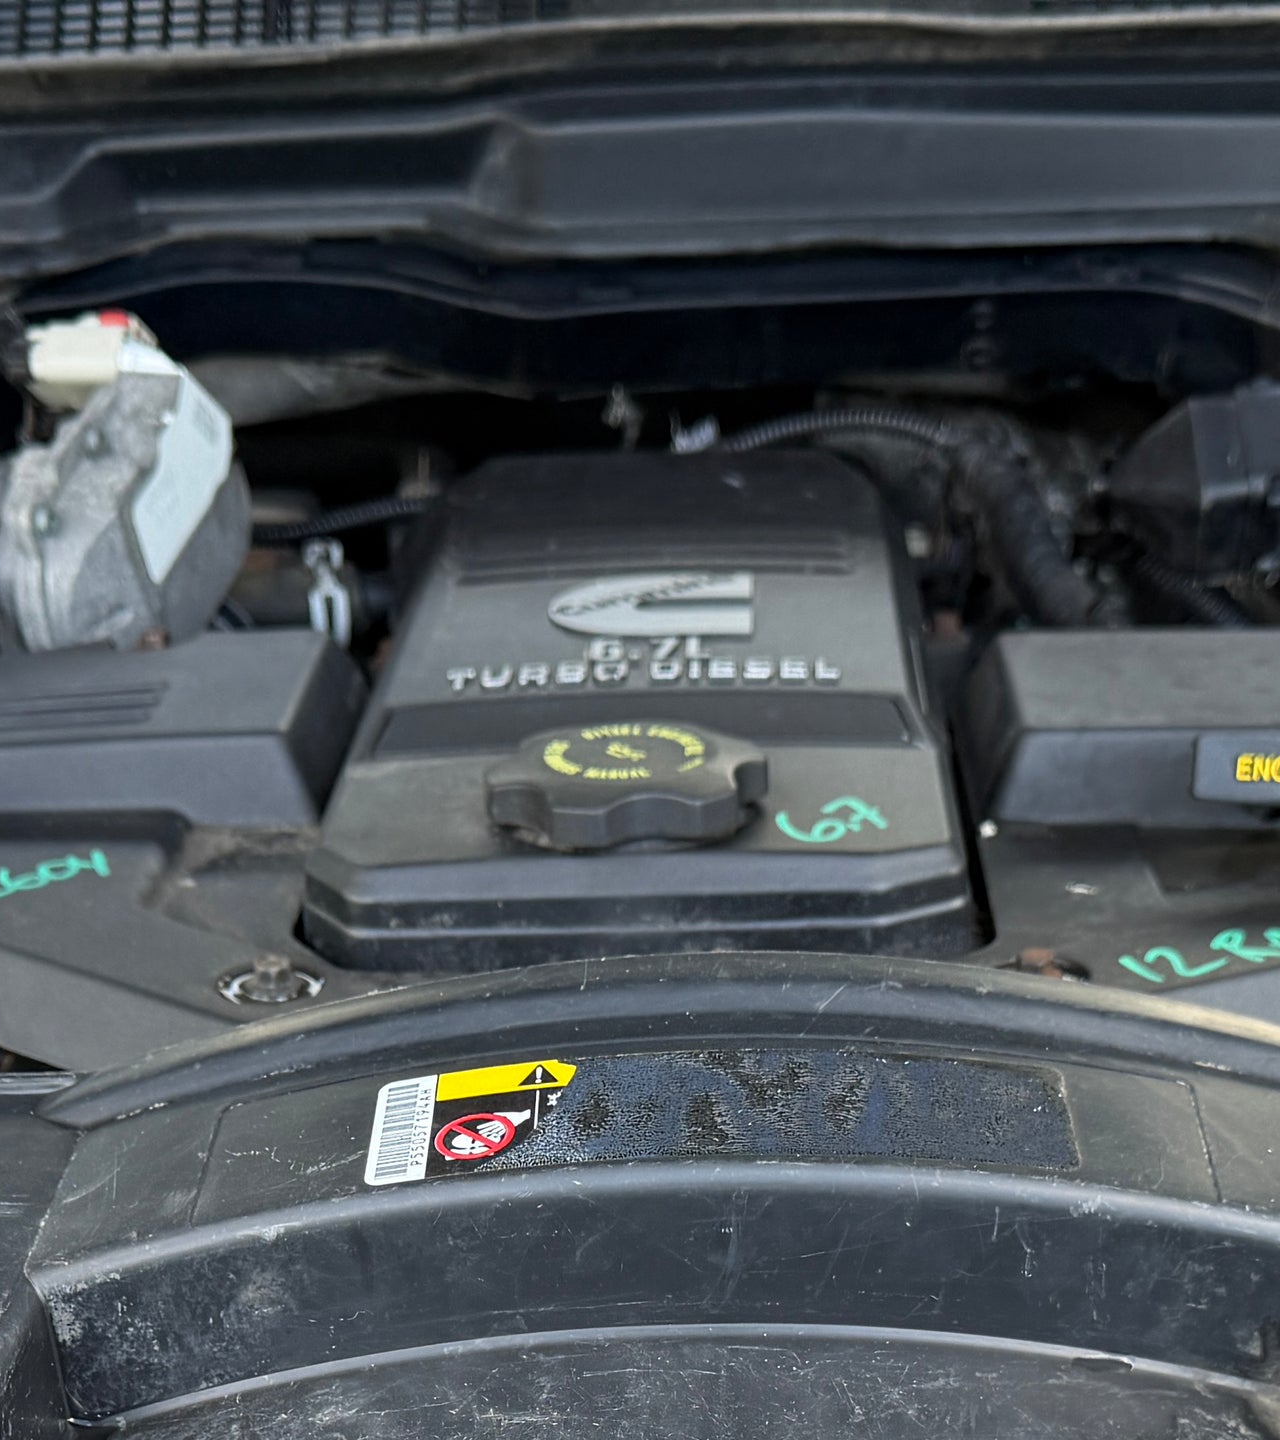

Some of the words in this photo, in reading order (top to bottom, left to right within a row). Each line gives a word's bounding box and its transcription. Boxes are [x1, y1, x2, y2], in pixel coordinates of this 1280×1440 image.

[446, 659, 629, 692] TURBO
[649, 656, 842, 682] DIESEL
[1118, 946, 1229, 984] 12
